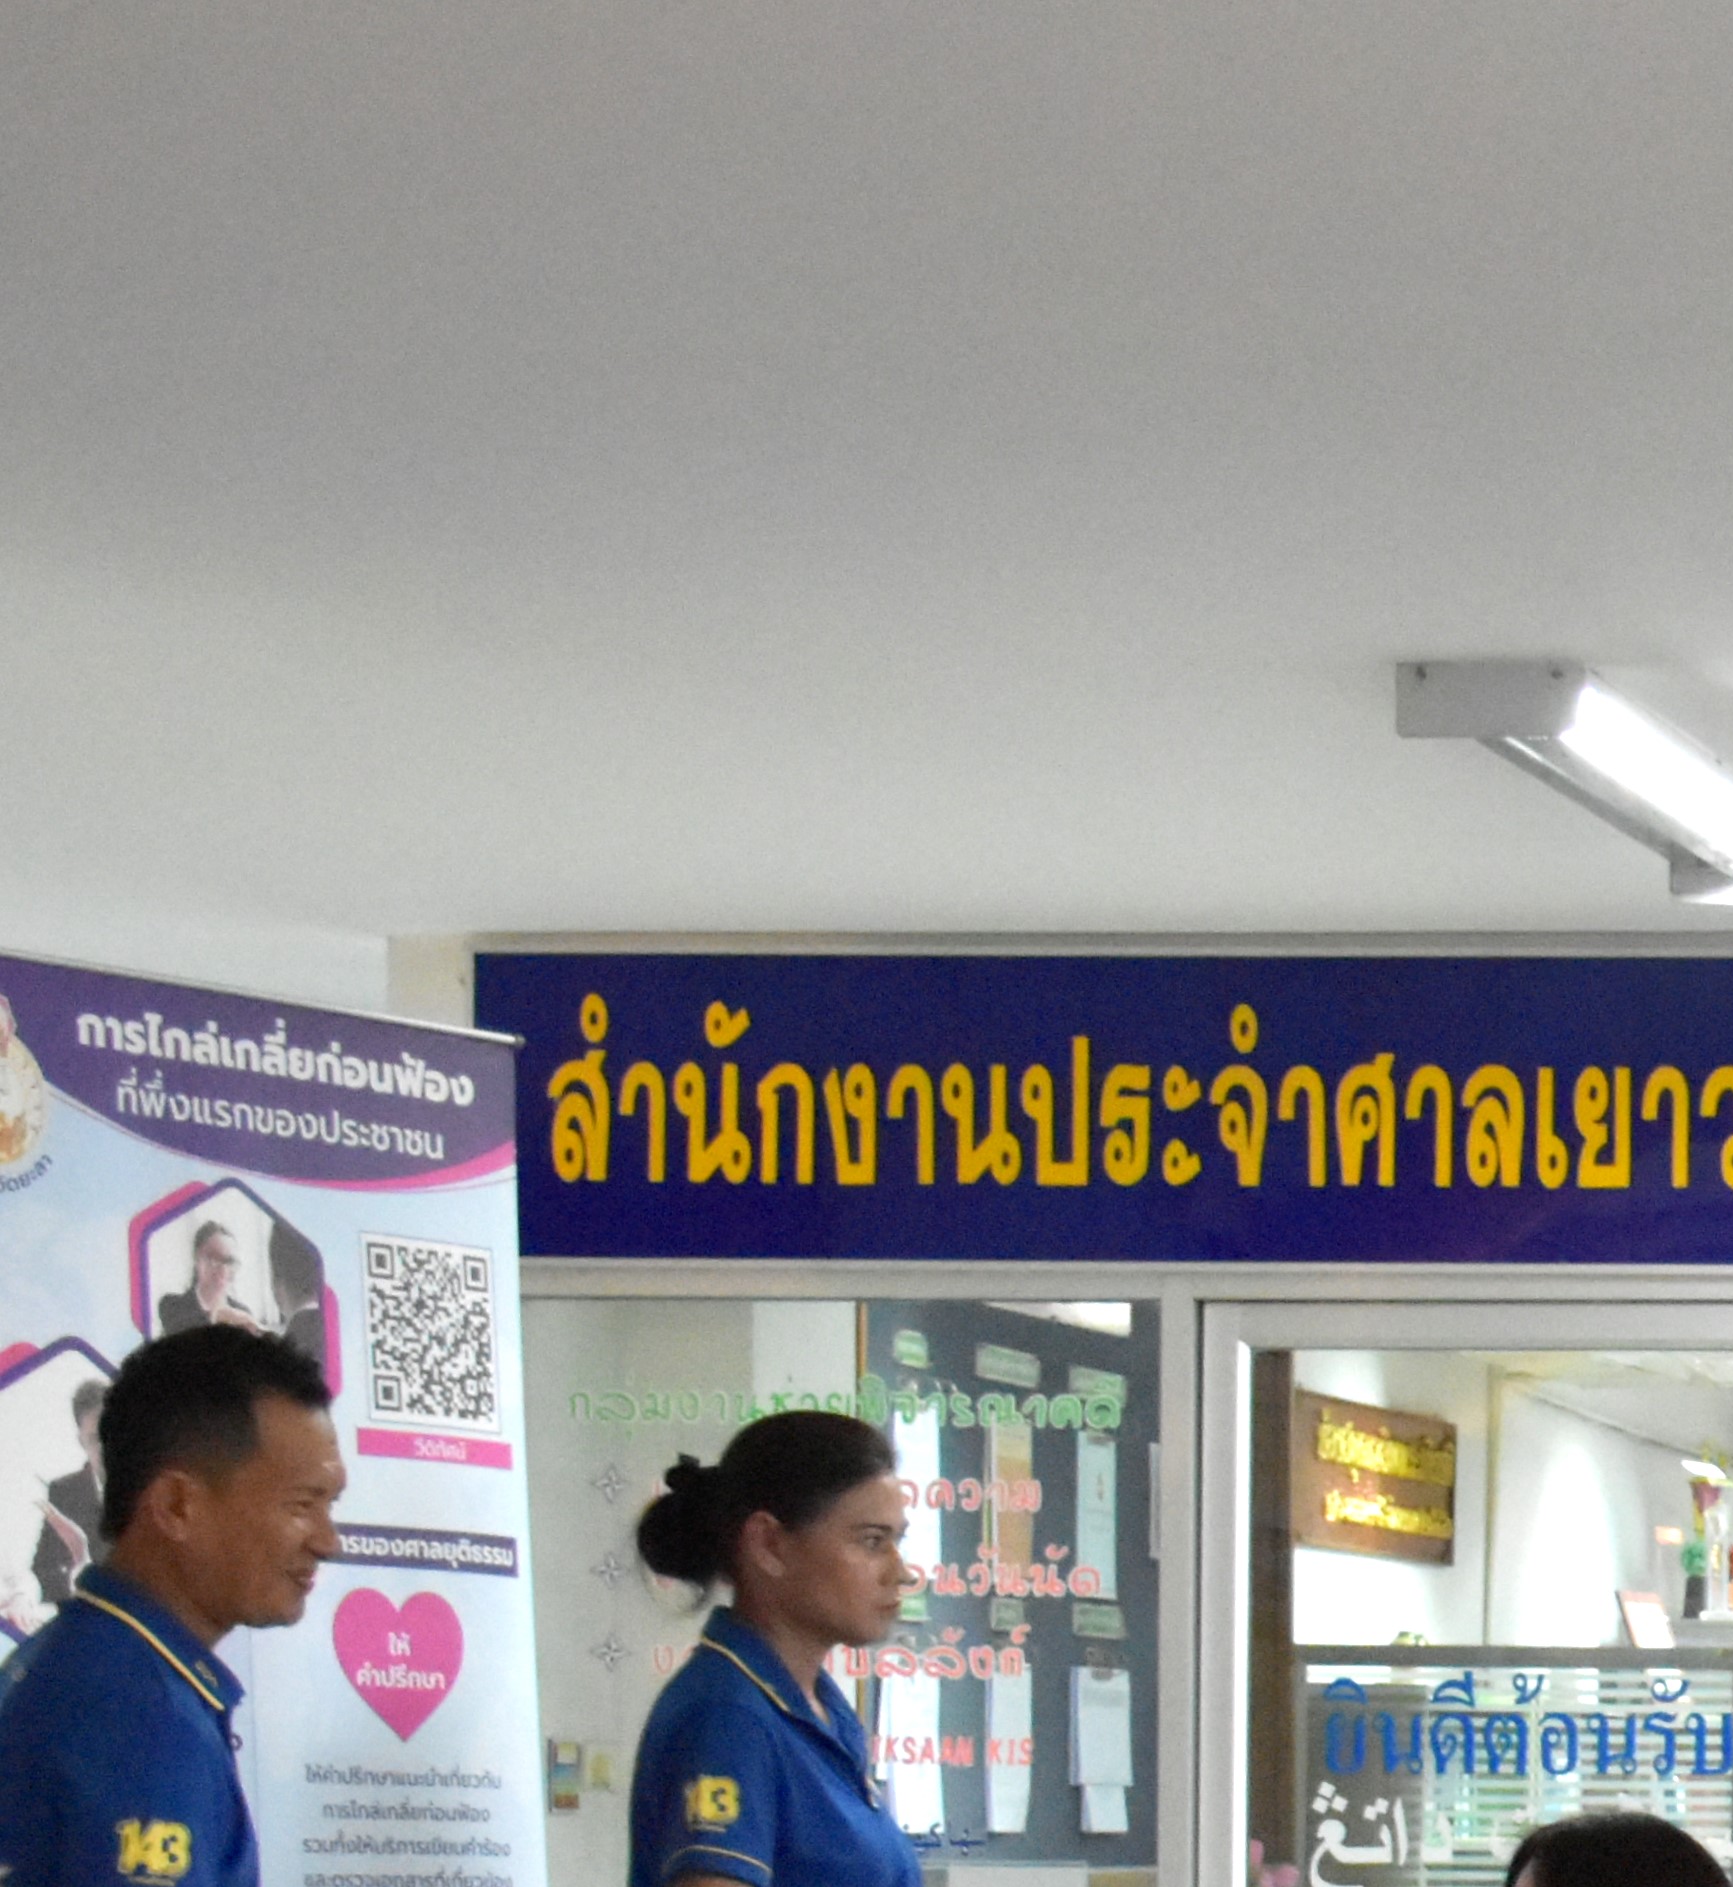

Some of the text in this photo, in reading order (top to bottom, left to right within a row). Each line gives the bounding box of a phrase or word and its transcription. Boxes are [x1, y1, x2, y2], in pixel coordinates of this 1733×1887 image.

[77, 1012, 475, 1106] การไกล่เกลี่ยก่อนฟ้อง
[116, 1068, 444, 1160] ที่พึ่งแรกของประชาชน
[340, 1534, 514, 1569] ารของศาลยุติธรรม
[388, 1632, 411, 1656] ให้
[356, 1663, 446, 1690] คำปรึกษา
[1323, 1671, 1733, 1776] ยินดีต้อนรับ
